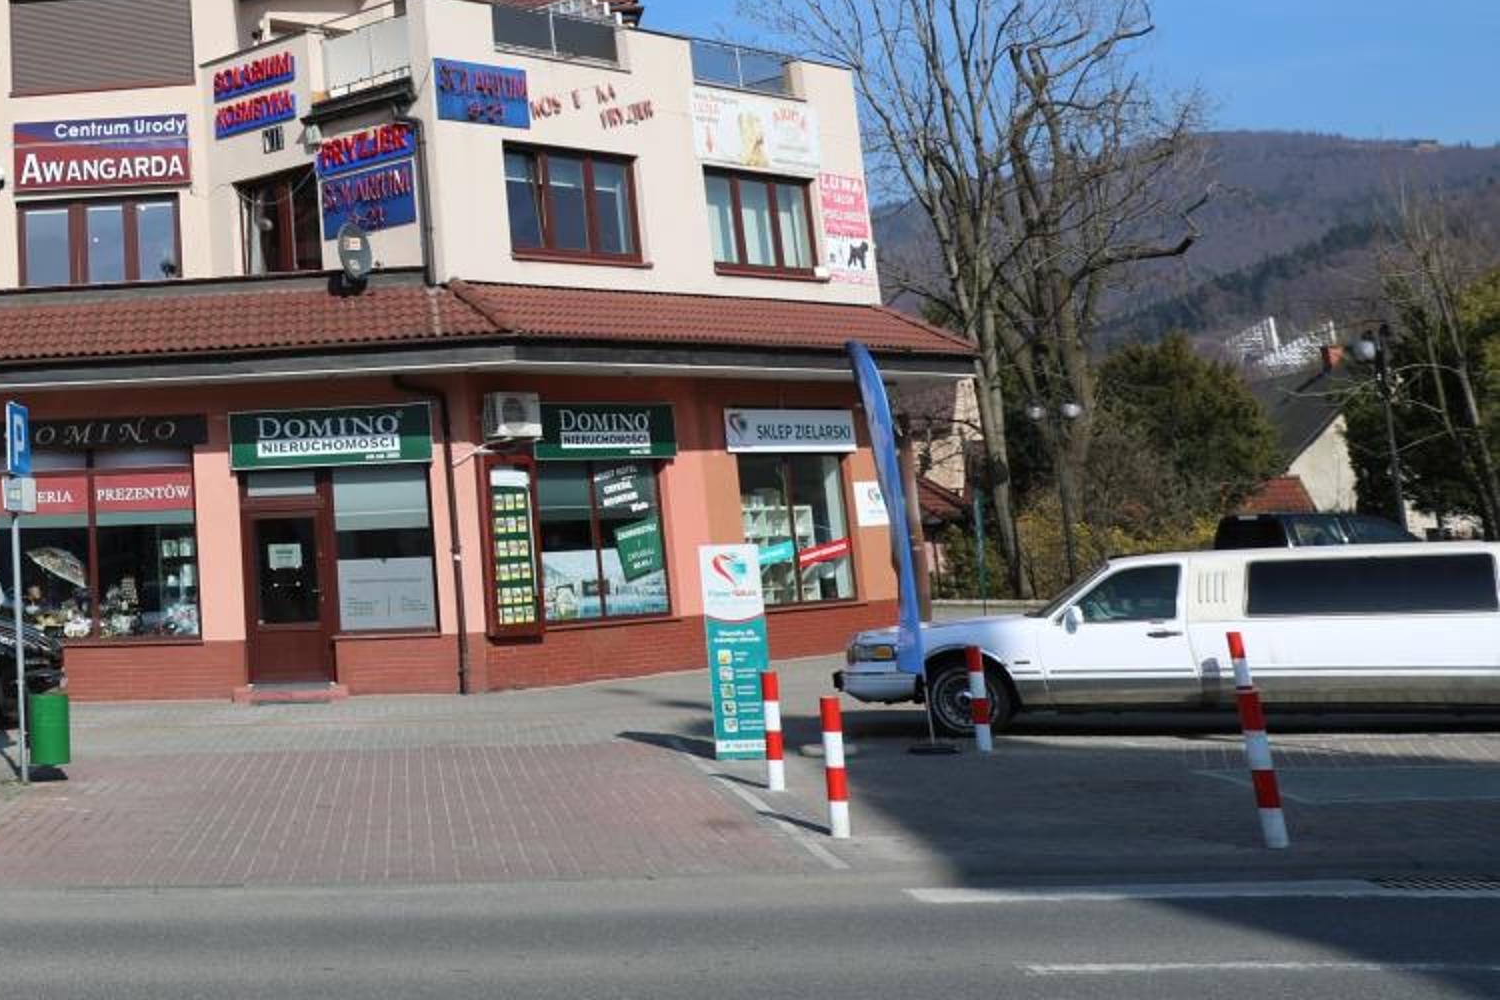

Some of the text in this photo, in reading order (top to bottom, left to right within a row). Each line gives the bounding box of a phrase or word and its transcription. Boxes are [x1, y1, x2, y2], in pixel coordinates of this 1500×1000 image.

[54, 117, 187, 139] Centrum Urody
[322, 124, 407, 169] FRYZJER
[20, 153, 184, 185] AWANGARDA
[258, 415, 399, 439] DOMINO
[560, 409, 649, 431] DOMINO
[35, 419, 176, 446] OMINO
[757, 424, 850, 440] SKLEP ZIELARSKI
[36, 484, 190, 503] ERIA PREZENTÓW
